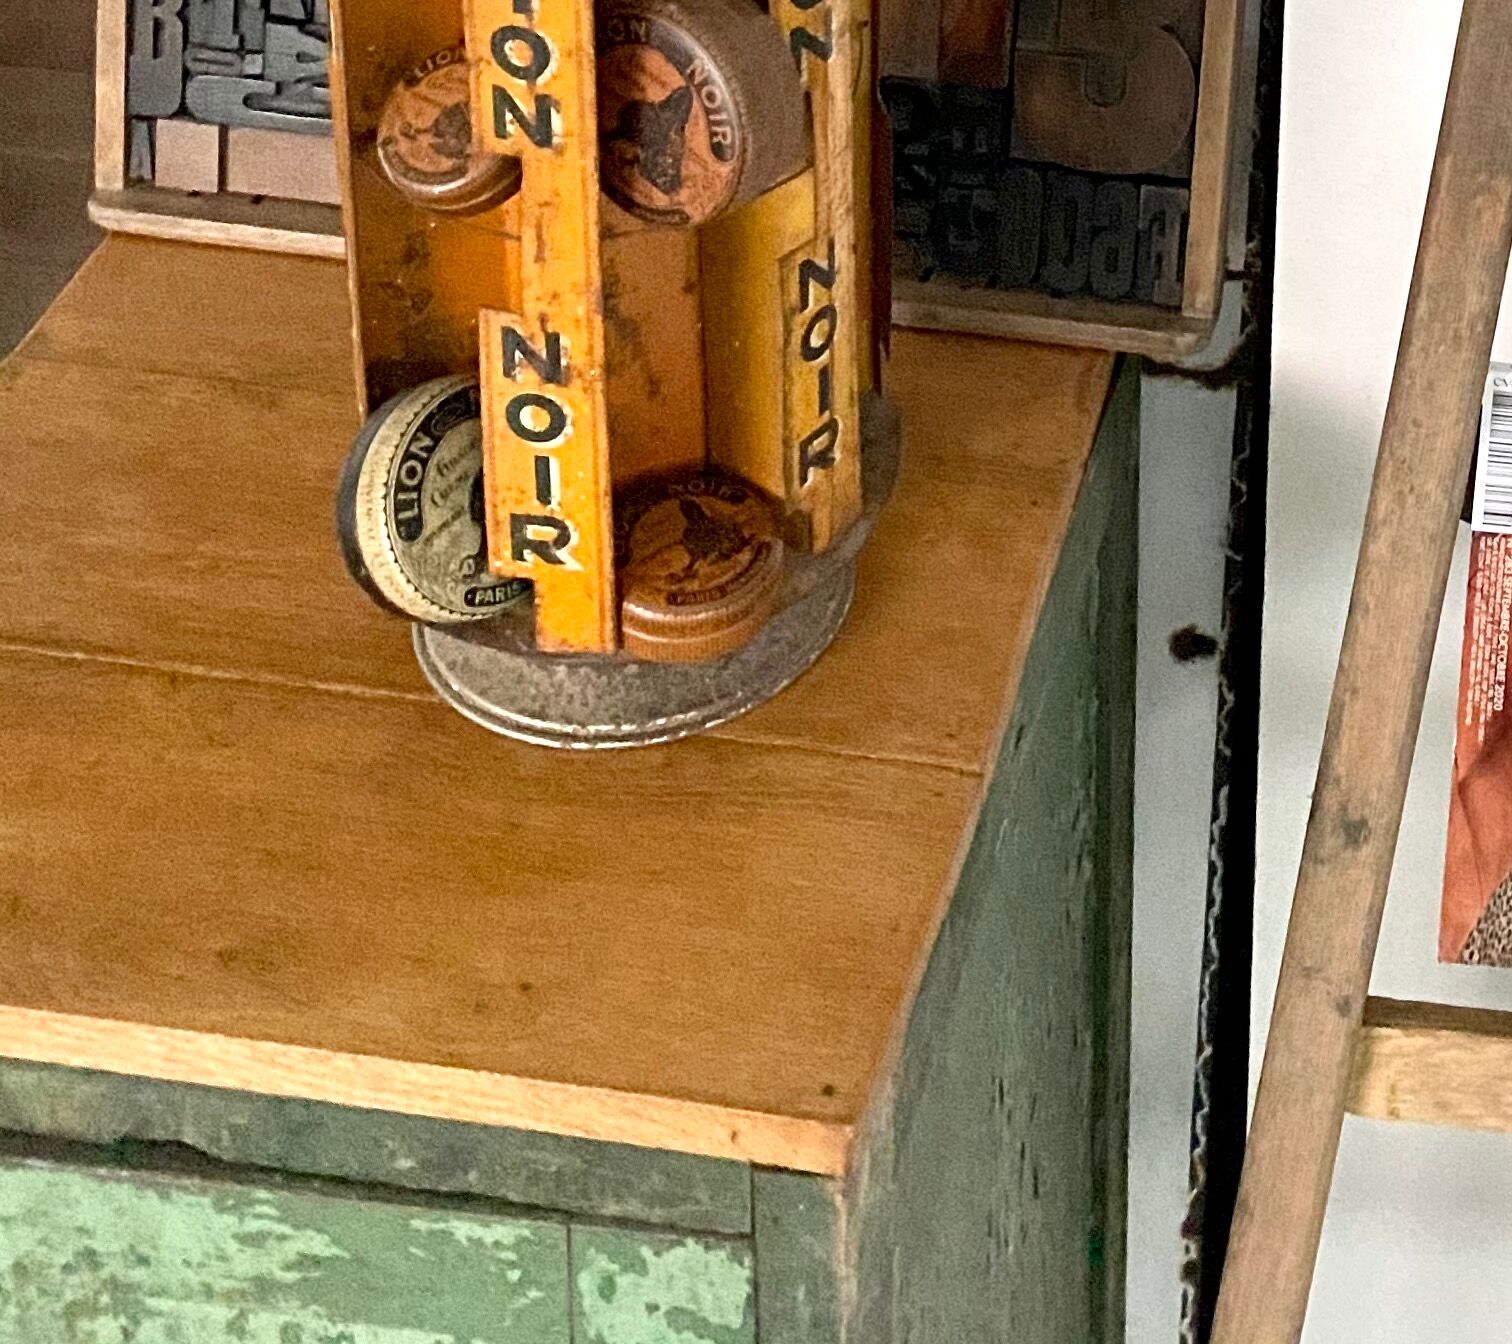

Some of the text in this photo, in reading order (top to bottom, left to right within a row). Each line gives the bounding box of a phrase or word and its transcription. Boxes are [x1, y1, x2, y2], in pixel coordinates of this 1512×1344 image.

[686, 57, 734, 146] NOIR
[799, 241, 842, 488] NOIR
[394, 434, 435, 515] LION
[500, 325, 576, 567] NOIR
[473, 580, 524, 606] PARIS
[1493, 683, 1505, 712] 2020
